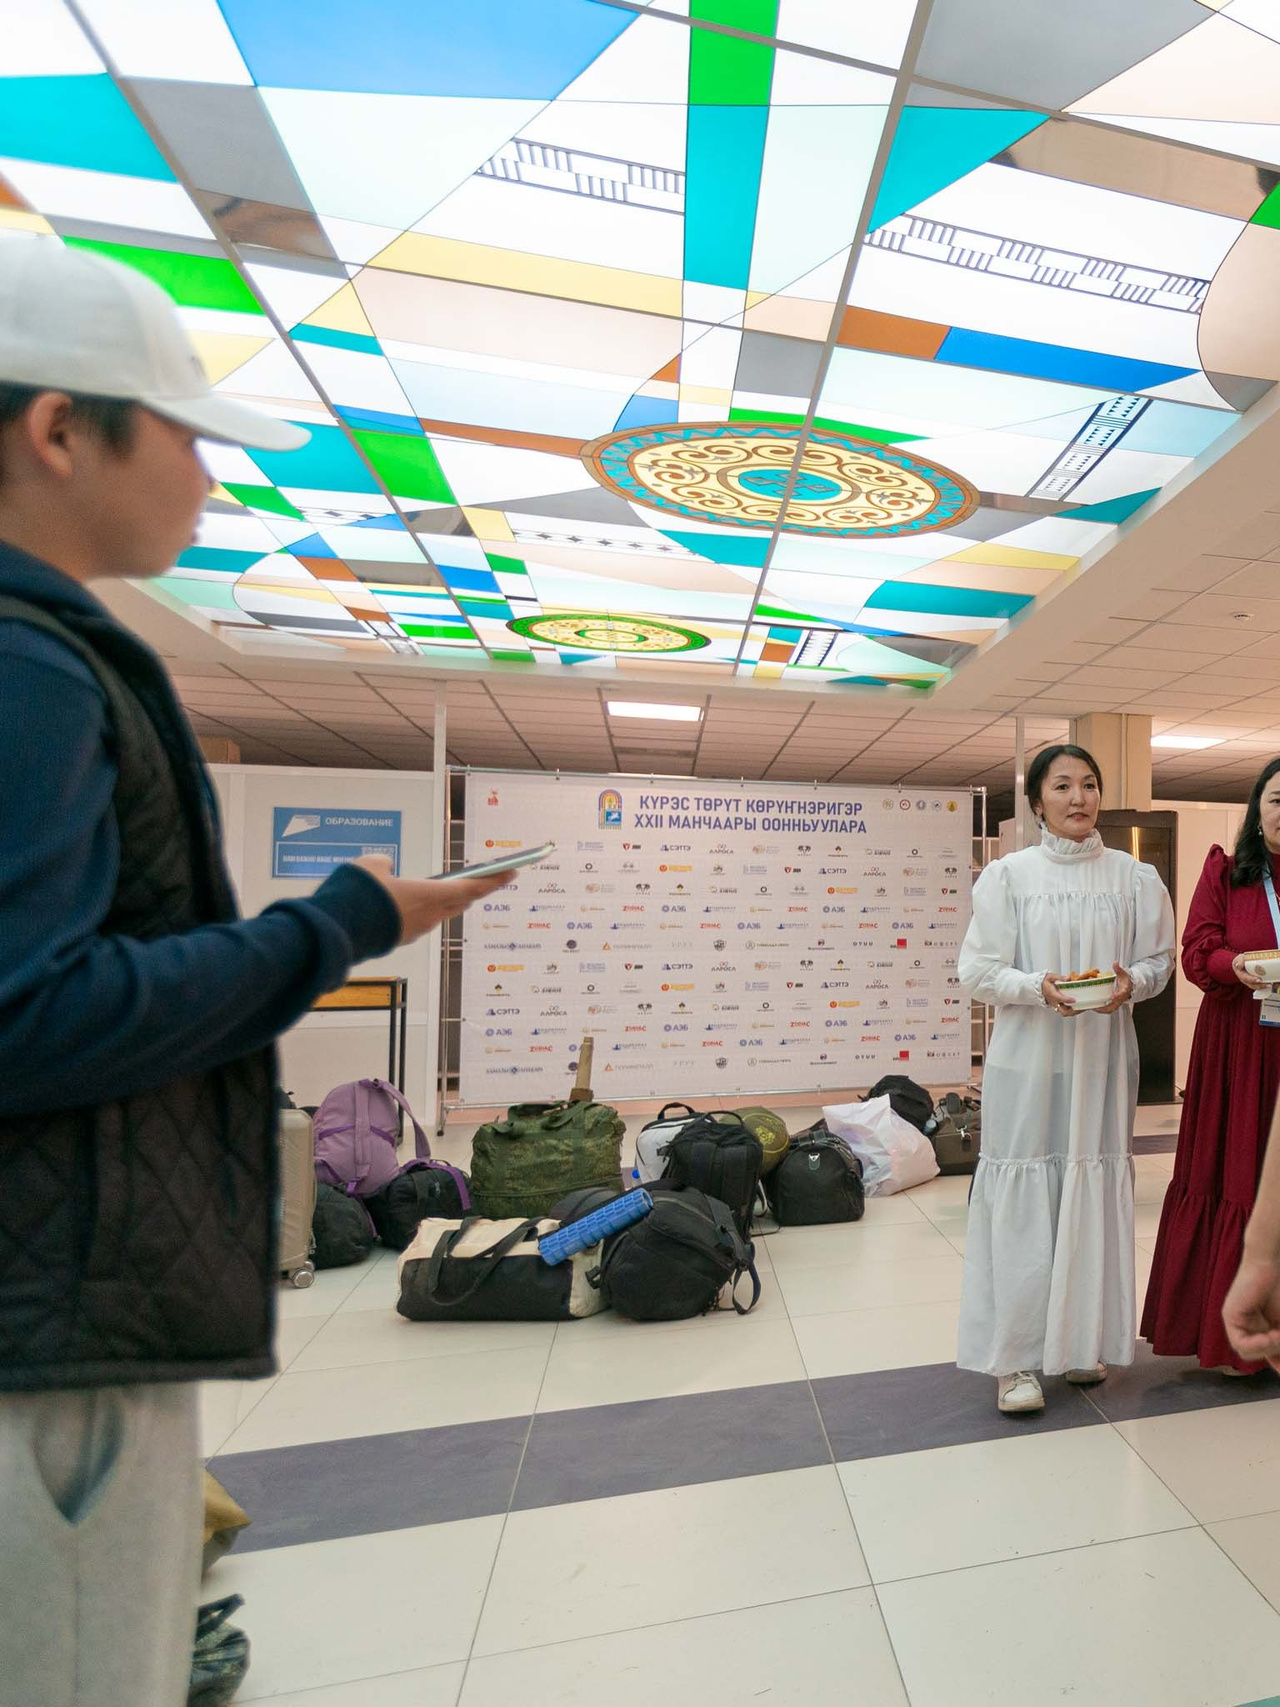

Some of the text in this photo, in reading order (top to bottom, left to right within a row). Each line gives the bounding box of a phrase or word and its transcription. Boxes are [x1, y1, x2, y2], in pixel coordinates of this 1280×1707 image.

[640, 795, 690, 811] КҮРЭС
[694, 797, 742, 813] ТӨРҮТ
[325, 816, 394, 827] ОБРАЗОВАНИЕ
[668, 815, 757, 831] МАНЧААРЫ
[762, 817, 867, 834] ООННЬУУЛАРА
[829, 981, 849, 989] СЭТТЭ
[497, 1008, 520, 1016] СЭТТЭ
